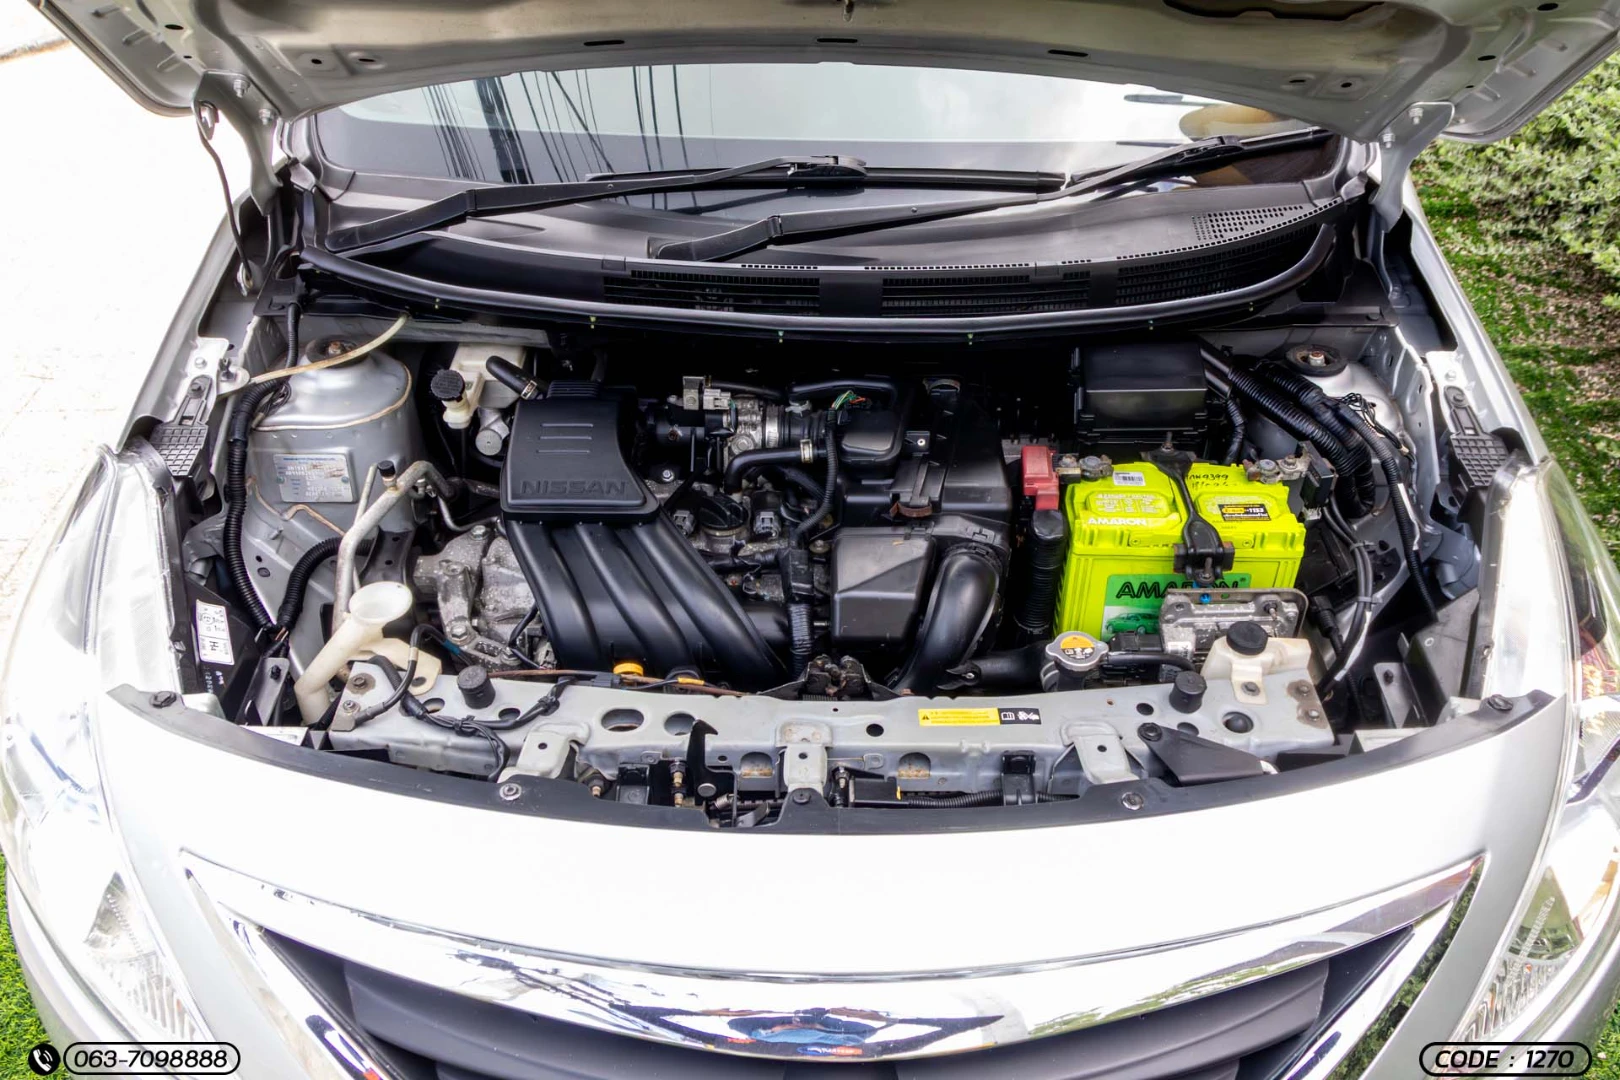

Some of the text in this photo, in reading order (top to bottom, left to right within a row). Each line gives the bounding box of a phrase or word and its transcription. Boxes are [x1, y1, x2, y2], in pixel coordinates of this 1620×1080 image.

[521, 480, 627, 495] NISSAN
[1088, 517, 1148, 526] AMARON
[1116, 581, 1239, 599] AMA
